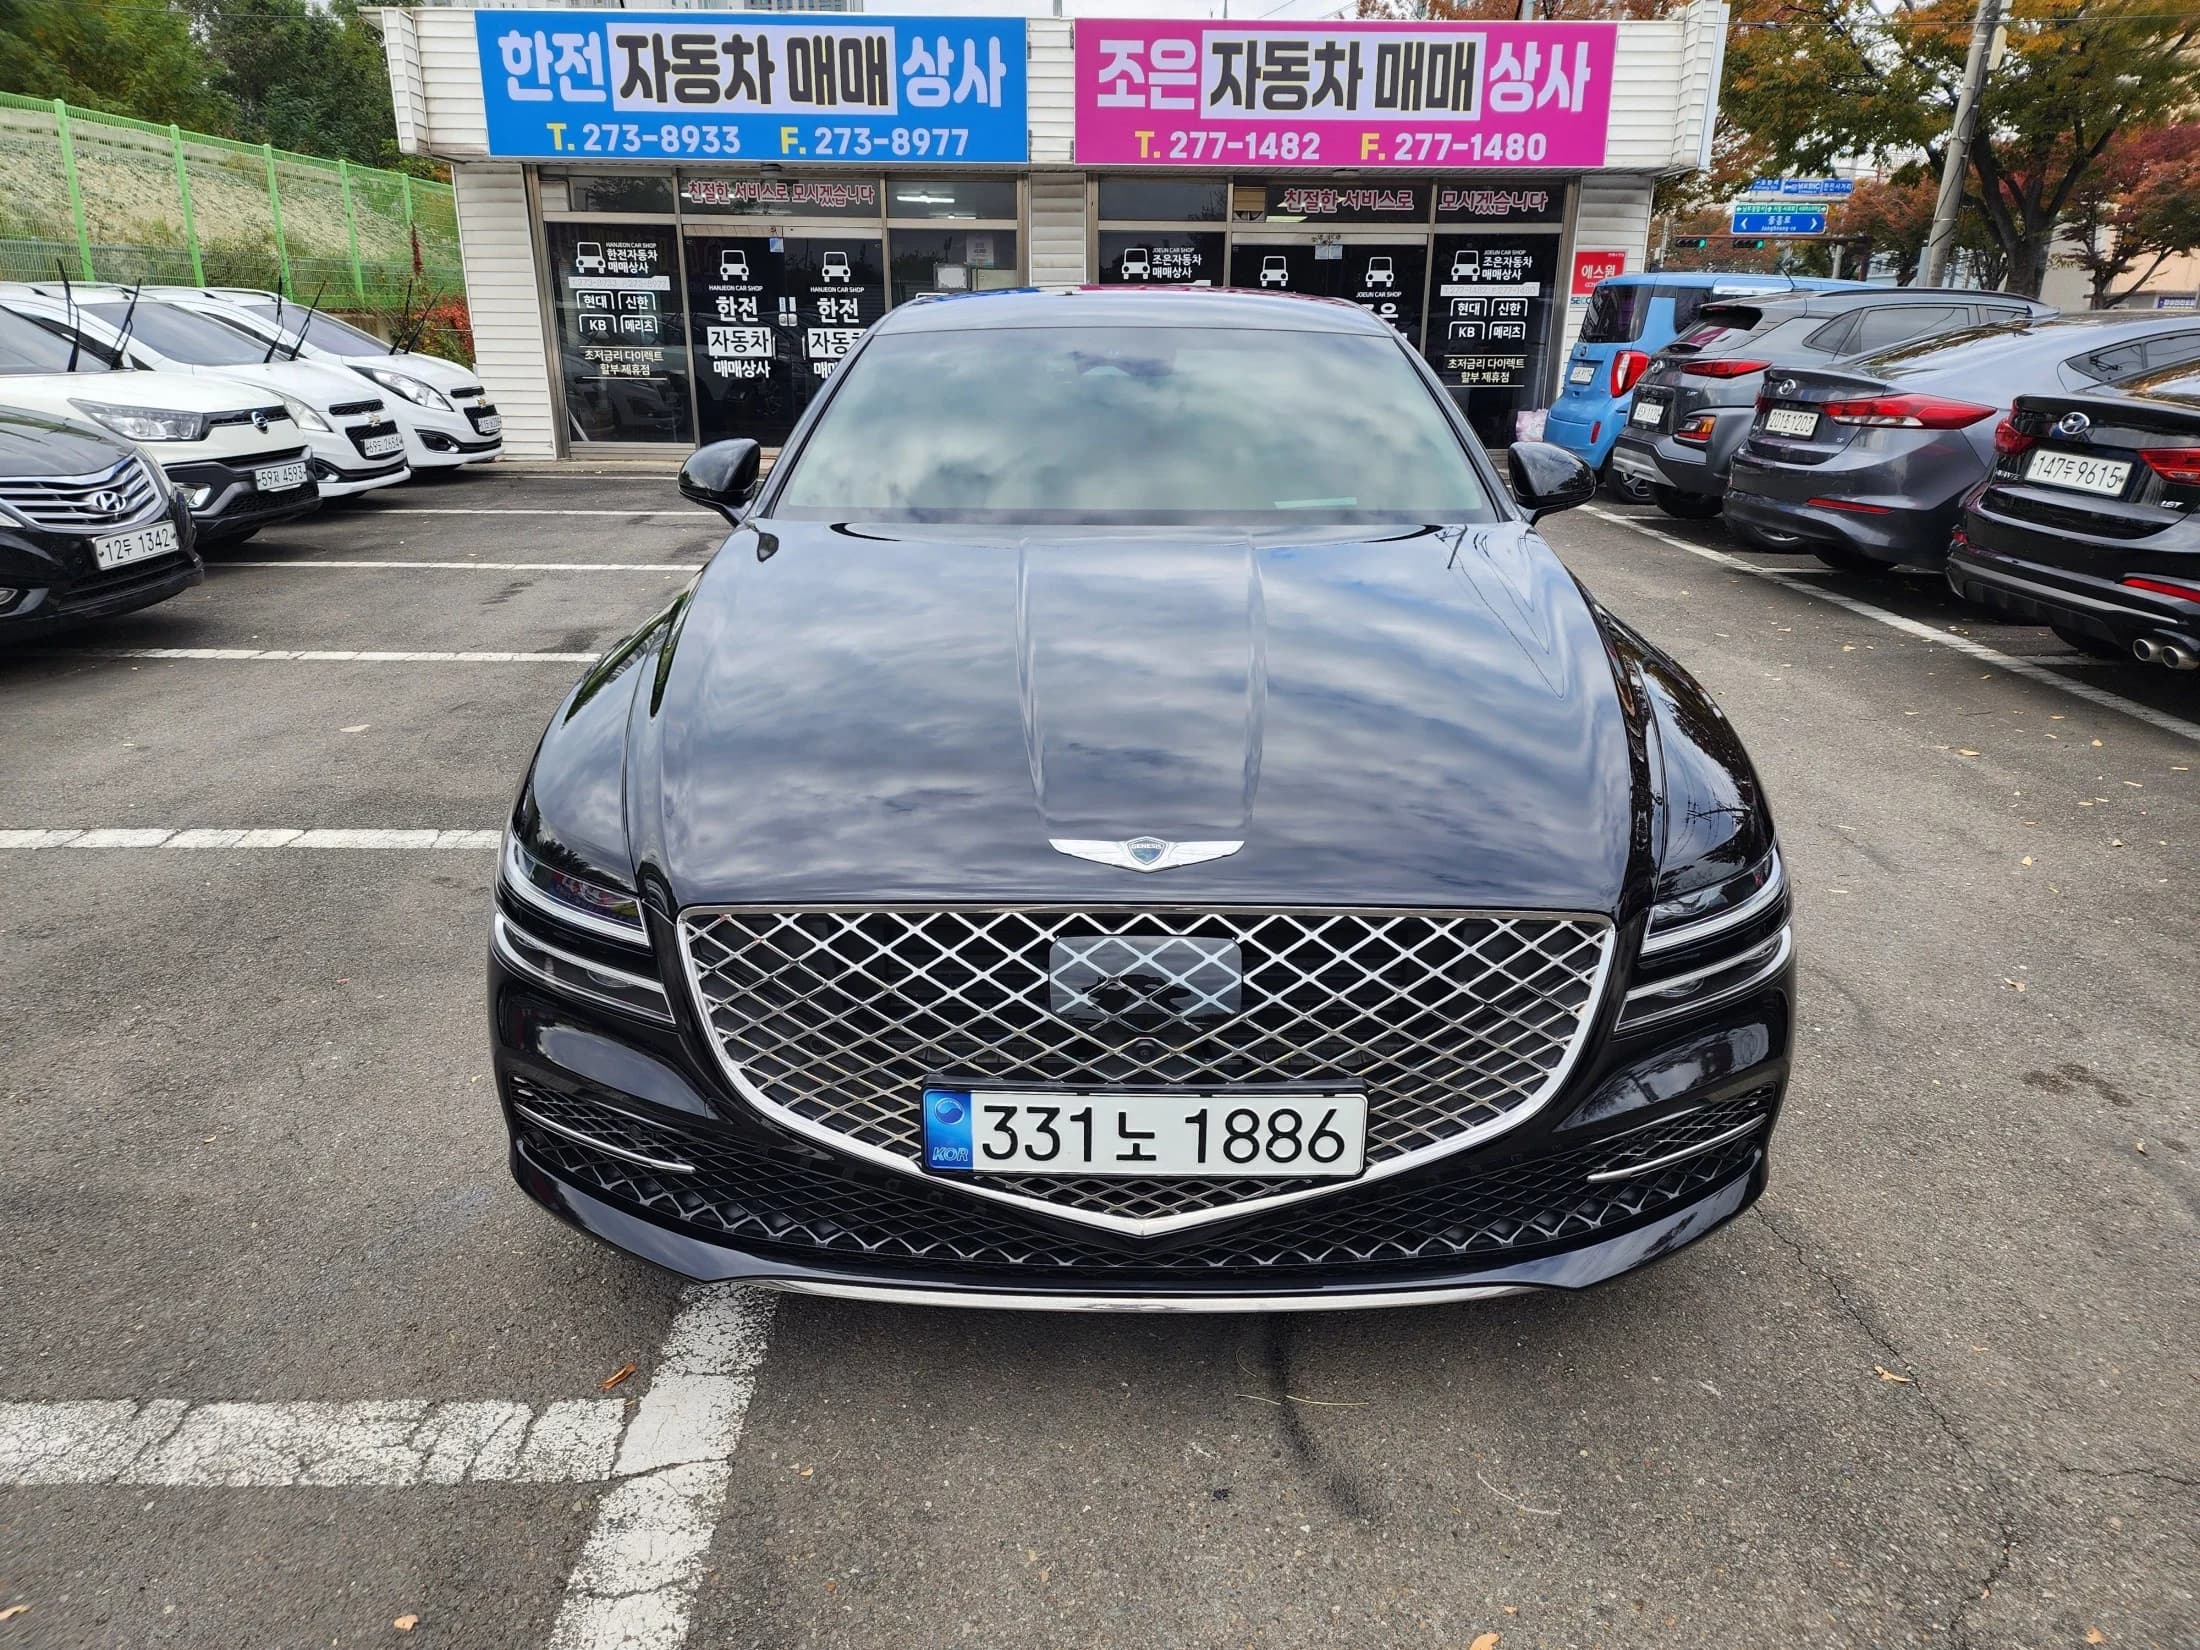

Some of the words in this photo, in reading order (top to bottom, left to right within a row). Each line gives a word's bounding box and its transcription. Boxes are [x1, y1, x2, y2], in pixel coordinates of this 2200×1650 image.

[498, 30, 607, 103] 한전
[616, 33, 775, 104] 자동차
[788, 34, 890, 107] 매매
[902, 35, 1007, 108] 상사
[1097, 38, 1199, 112] 조은
[1208, 39, 1363, 112] 자동차
[1374, 41, 1478, 113] 매매
[1489, 41, 1591, 115] 상사
[547, 122, 575, 151] T.
[582, 123, 741, 154] 273-8933
[781, 126, 806, 155] F.
[814, 126, 969, 157] 273-8977
[1135, 130, 1161, 159] T.
[1169, 130, 1320, 161] 277-1482
[1360, 132, 1386, 161] F.
[1394, 131, 1547, 162] 277-1480
[688, 180, 729, 205] 친절한
[734, 181, 788, 204] 서비스로
[791, 183, 876, 207] 모시겠습니다
[1284, 187, 1339, 213] 친절한
[1342, 189, 1415, 211] 서비스로
[1438, 188, 1549, 213] 모시겠습니다
[607, 248, 659, 262] 한전자동차
[1151, 254, 1203, 266] 조은자동차
[1482, 256, 1533, 269] 조은자동차
[607, 261, 650, 274] 매매상사
[1152, 266, 1192, 279] 매매상사
[1481, 268, 1522, 281] 매매상사
[1581, 264, 1616, 279] 에스원
[583, 295, 609, 310] 현대
[625, 296, 649, 310] 신한
[715, 296, 759, 322] 한전
[1457, 303, 1480, 316] 현대
[1498, 303, 1521, 316] 신한
[817, 298, 860, 324] 한전
[589, 319, 607, 331] KB
[624, 319, 655, 333] 메리츠
[1458, 327, 1475, 338] KB
[1493, 326, 1521, 339] 메리츠
[711, 330, 769, 354] 자동차
[713, 360, 771, 379] 매매상사
[1447, 358, 1485, 370] 초저금리
[1487, 358, 1525, 370] 다이렉트
[1461, 371, 1479, 383] 할부
[1481, 371, 1510, 383] 제휴점
[283, 464, 304, 481] 4593
[105, 539, 133, 562] 12두
[138, 528, 171, 553] 1342
[981, 1105, 1157, 1162] 331노
[1184, 1107, 1346, 1165] 1886
[932, 1146, 969, 1162] KOR
